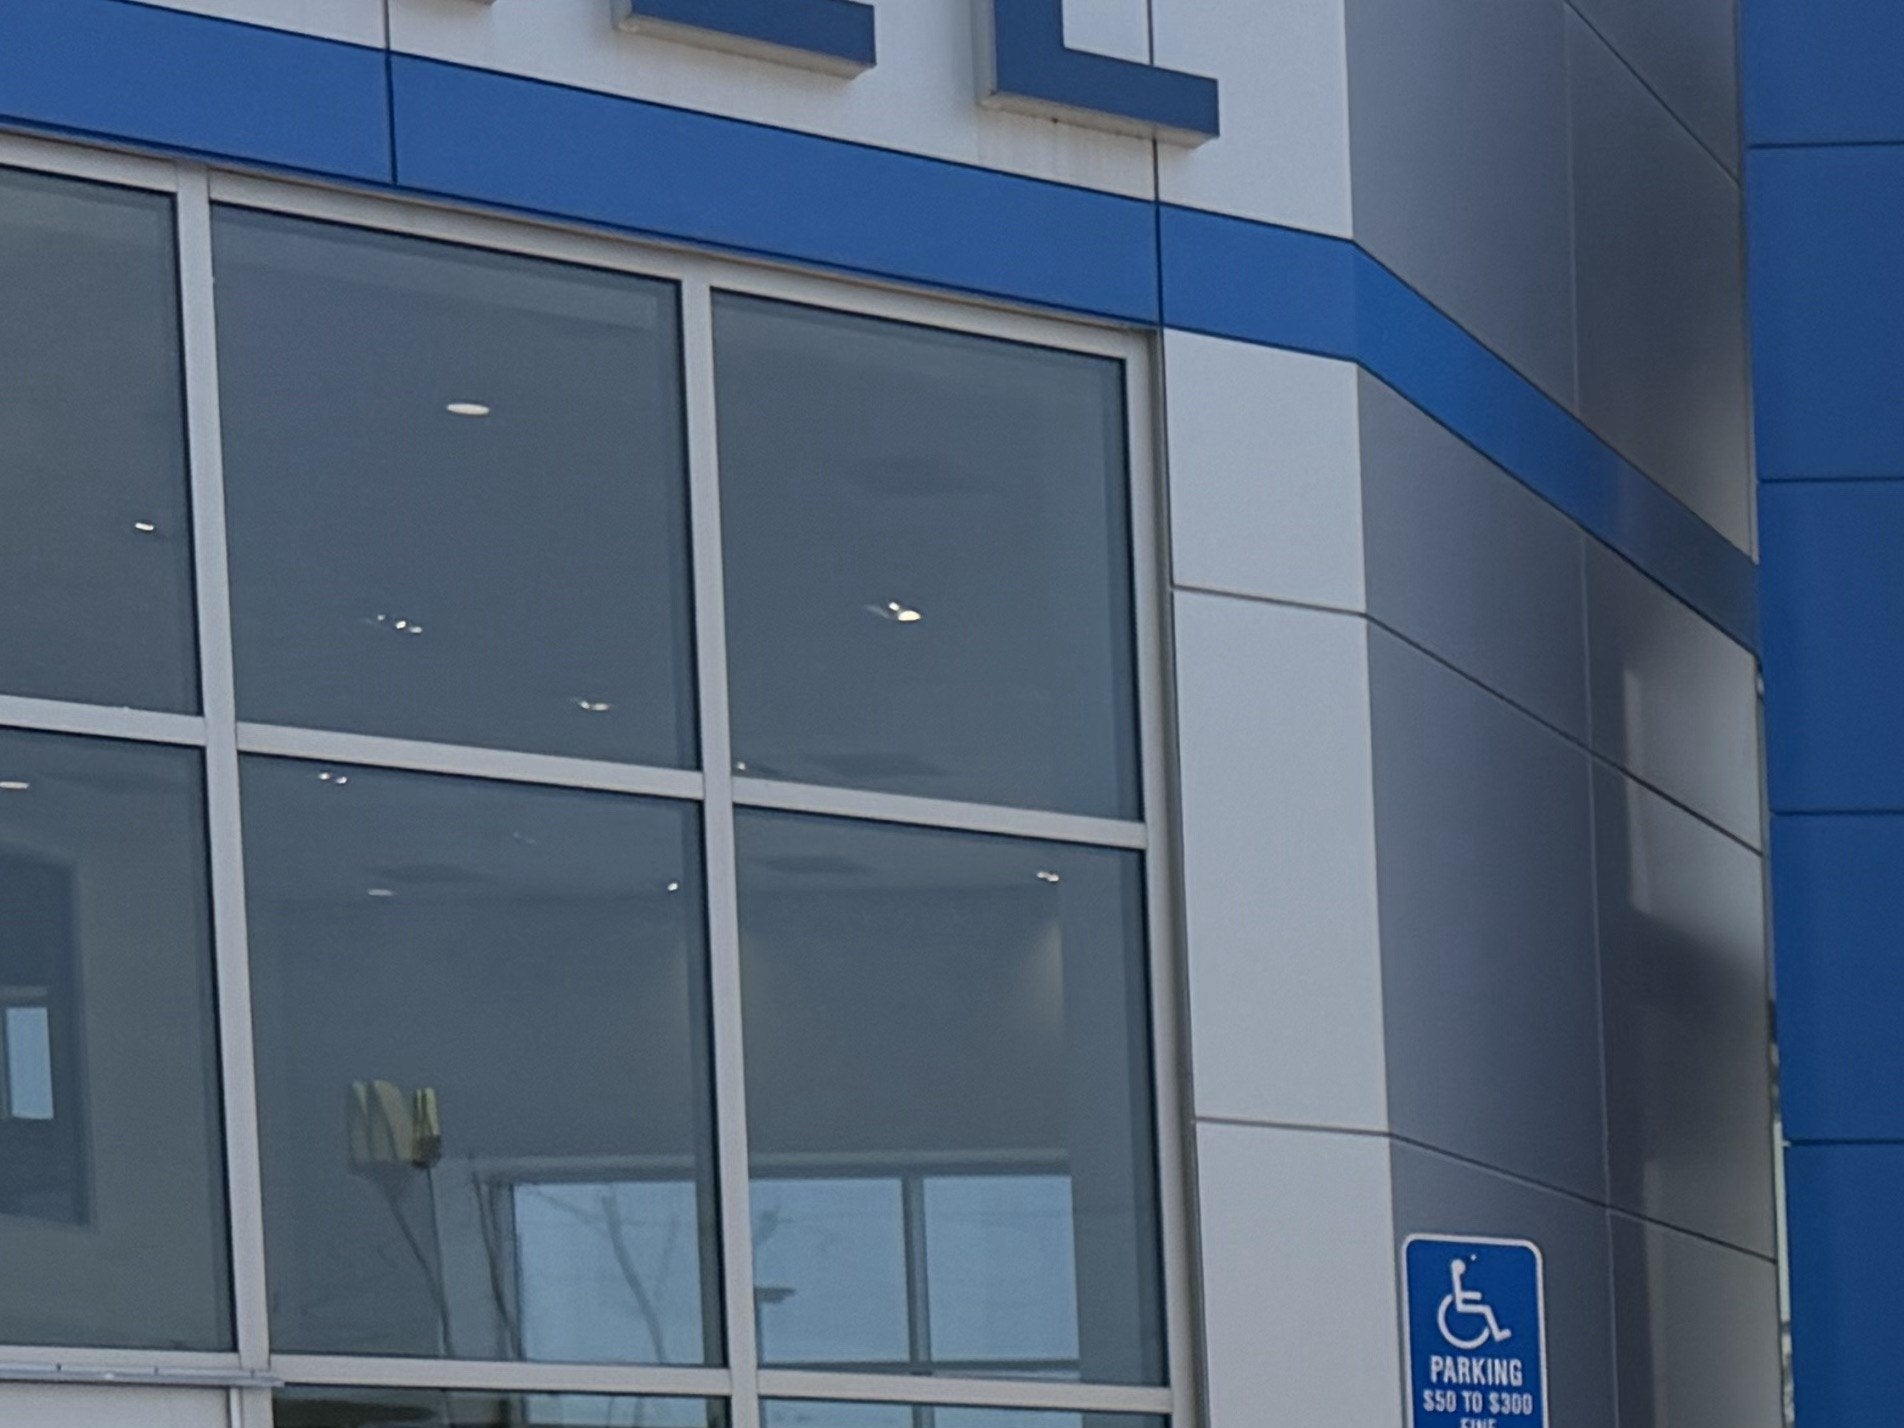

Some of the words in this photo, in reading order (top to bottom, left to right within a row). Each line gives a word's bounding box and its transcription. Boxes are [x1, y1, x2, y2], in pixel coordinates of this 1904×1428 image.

[1429, 1355, 1523, 1386] PARKING
[1422, 1389, 1458, 1413] $50
[1461, 1390, 1484, 1414] TO
[1487, 1391, 1534, 1415] $300
